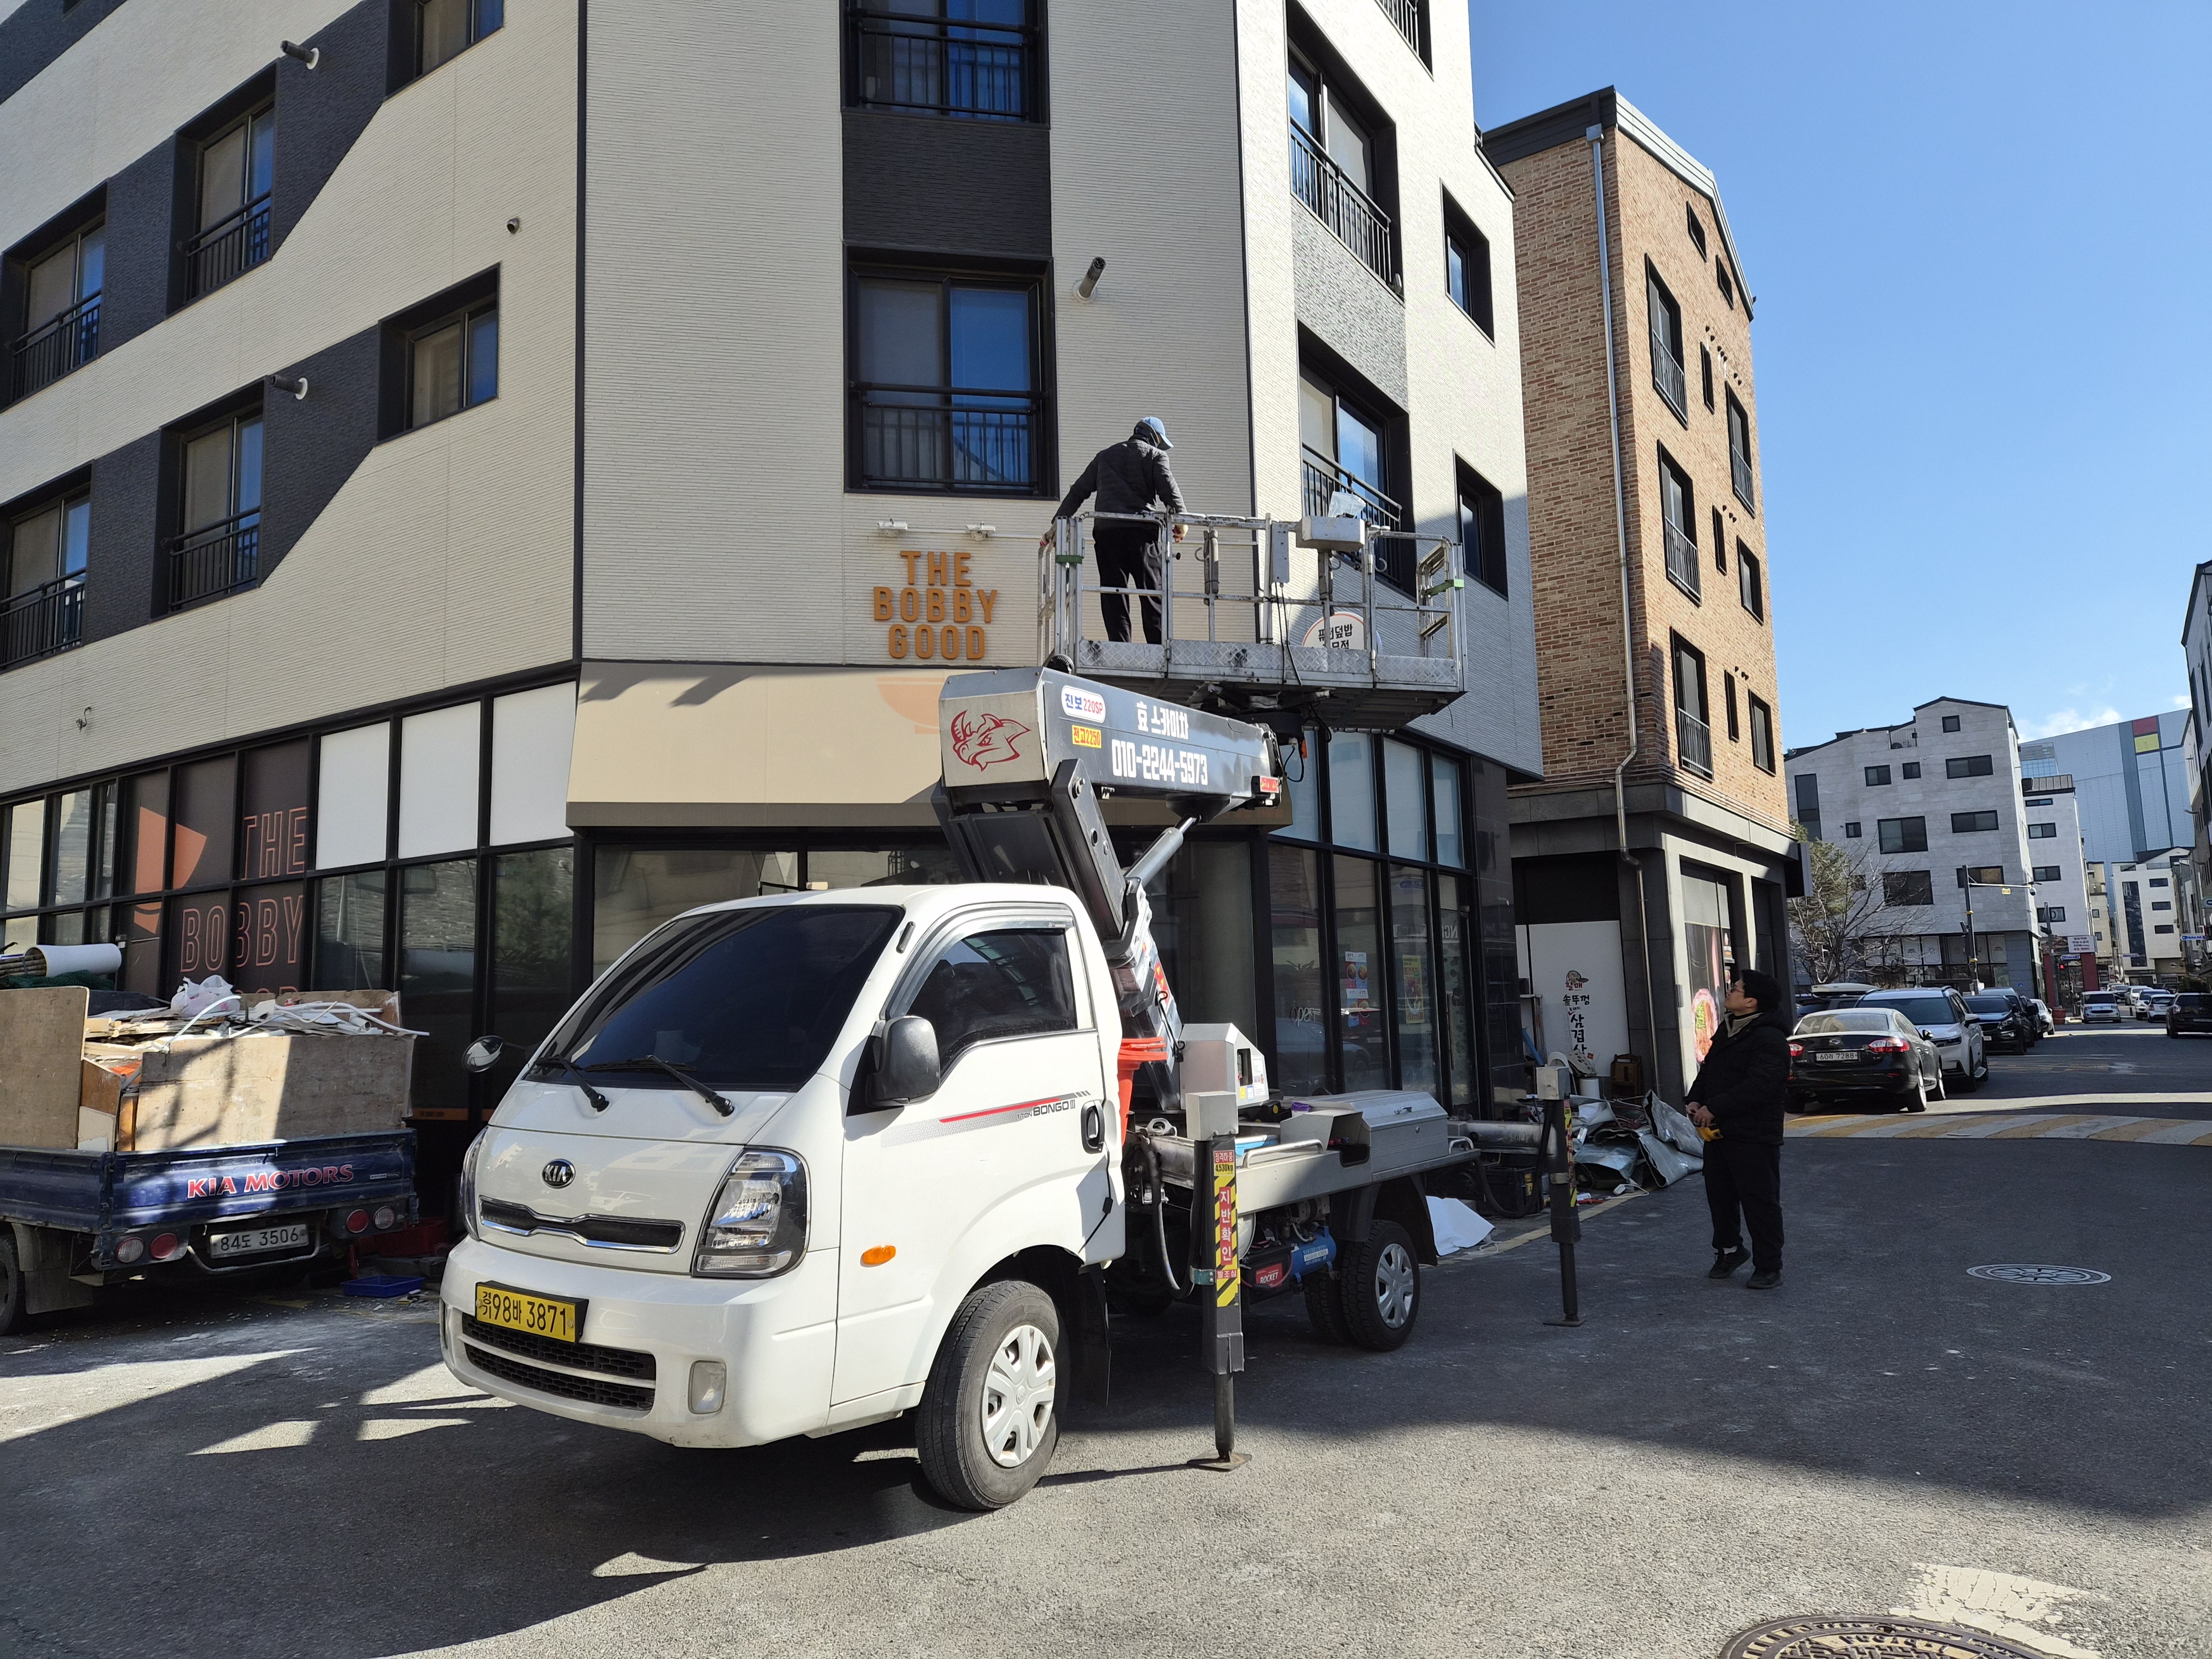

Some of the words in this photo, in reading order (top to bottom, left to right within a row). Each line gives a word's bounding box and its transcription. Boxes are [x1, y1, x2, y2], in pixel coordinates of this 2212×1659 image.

[900, 551, 972, 586] THE
[874, 587, 997, 623] BOBBY
[889, 624, 985, 659] GOOD
[1073, 727, 1100, 746] 전고2250
[1136, 701, 1149, 732] 효
[1151, 705, 1188, 739] 스카이차
[1112, 739, 1208, 785] 010-2244-5973
[244, 807, 307, 880] THE
[180, 895, 304, 973] BOBBY
[1563, 994, 1590, 1006] 솥뚜껑
[1566, 982, 1583, 991] 할매
[1033, 1101, 1069, 1117] BONGO
[187, 1176, 237, 1199] KIA
[244, 1164, 354, 1194] MOTORS
[545, 1165, 569, 1182] KIA
[221, 1234, 251, 1251] 84도
[259, 1227, 299, 1246] 3506
[1260, 1272, 1279, 1284] ROCKET
[526, 1301, 567, 1335] 3871
